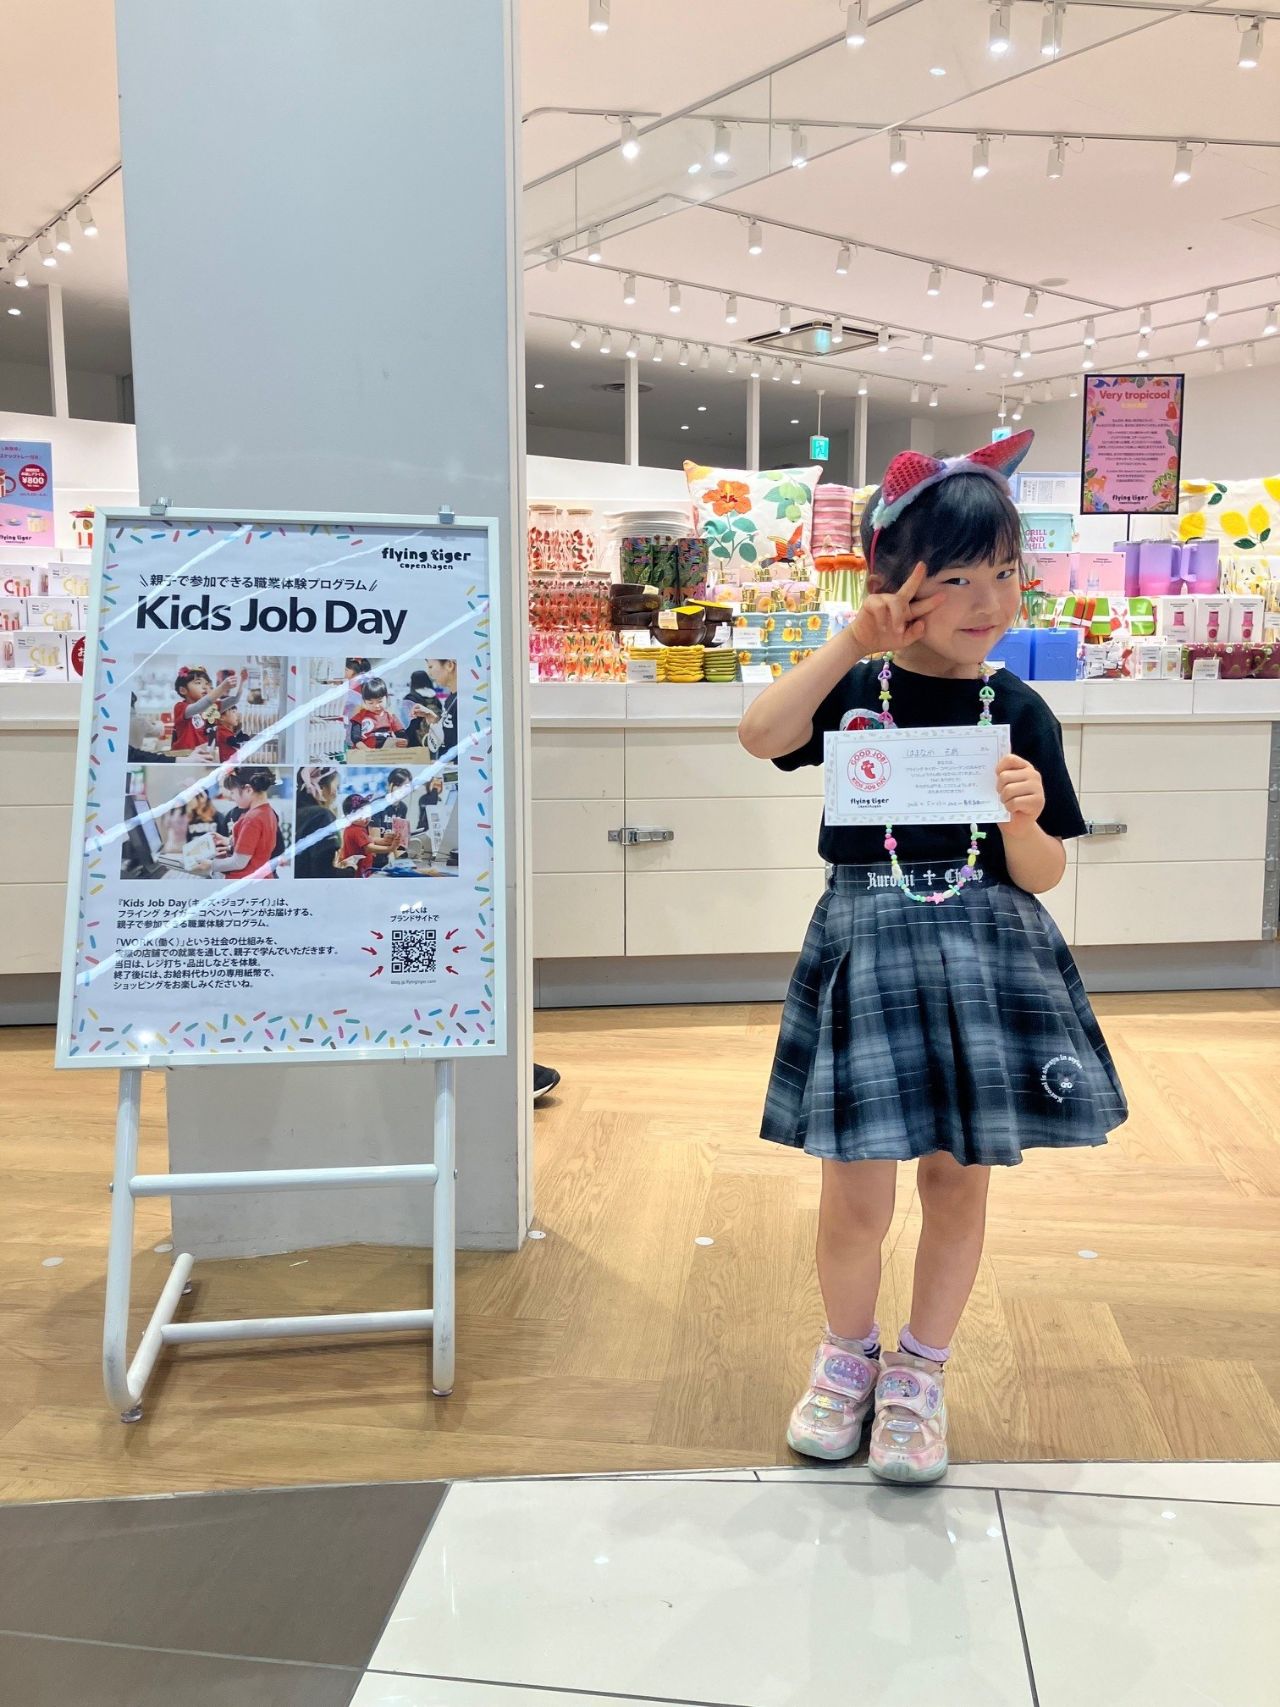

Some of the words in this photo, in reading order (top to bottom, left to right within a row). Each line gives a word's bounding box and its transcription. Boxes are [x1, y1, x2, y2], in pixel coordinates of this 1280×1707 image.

[1099, 390, 1122, 402] Very
[1124, 389, 1171, 402] tropicool
[22, 477, 44, 485] ¥800
[1024, 529, 1047, 537] GRILL
[1024, 542, 1047, 550] CHILL
[381, 547, 428, 562] flying
[431, 549, 471, 563] tiger
[400, 562, 454, 571] copenhagen
[150, 574, 367, 591] 親子で参加できる職業体験プログラム
[136, 594, 232, 631] Kids
[240, 597, 317, 633] Job
[325, 600, 408, 645] Day
[851, 750, 871, 765] GOOD
[850, 797, 871, 805] flying
[147, 898, 165, 908] Job
[118, 909, 160, 918] フライング
[390, 914, 440, 922] ブランドサイトで
